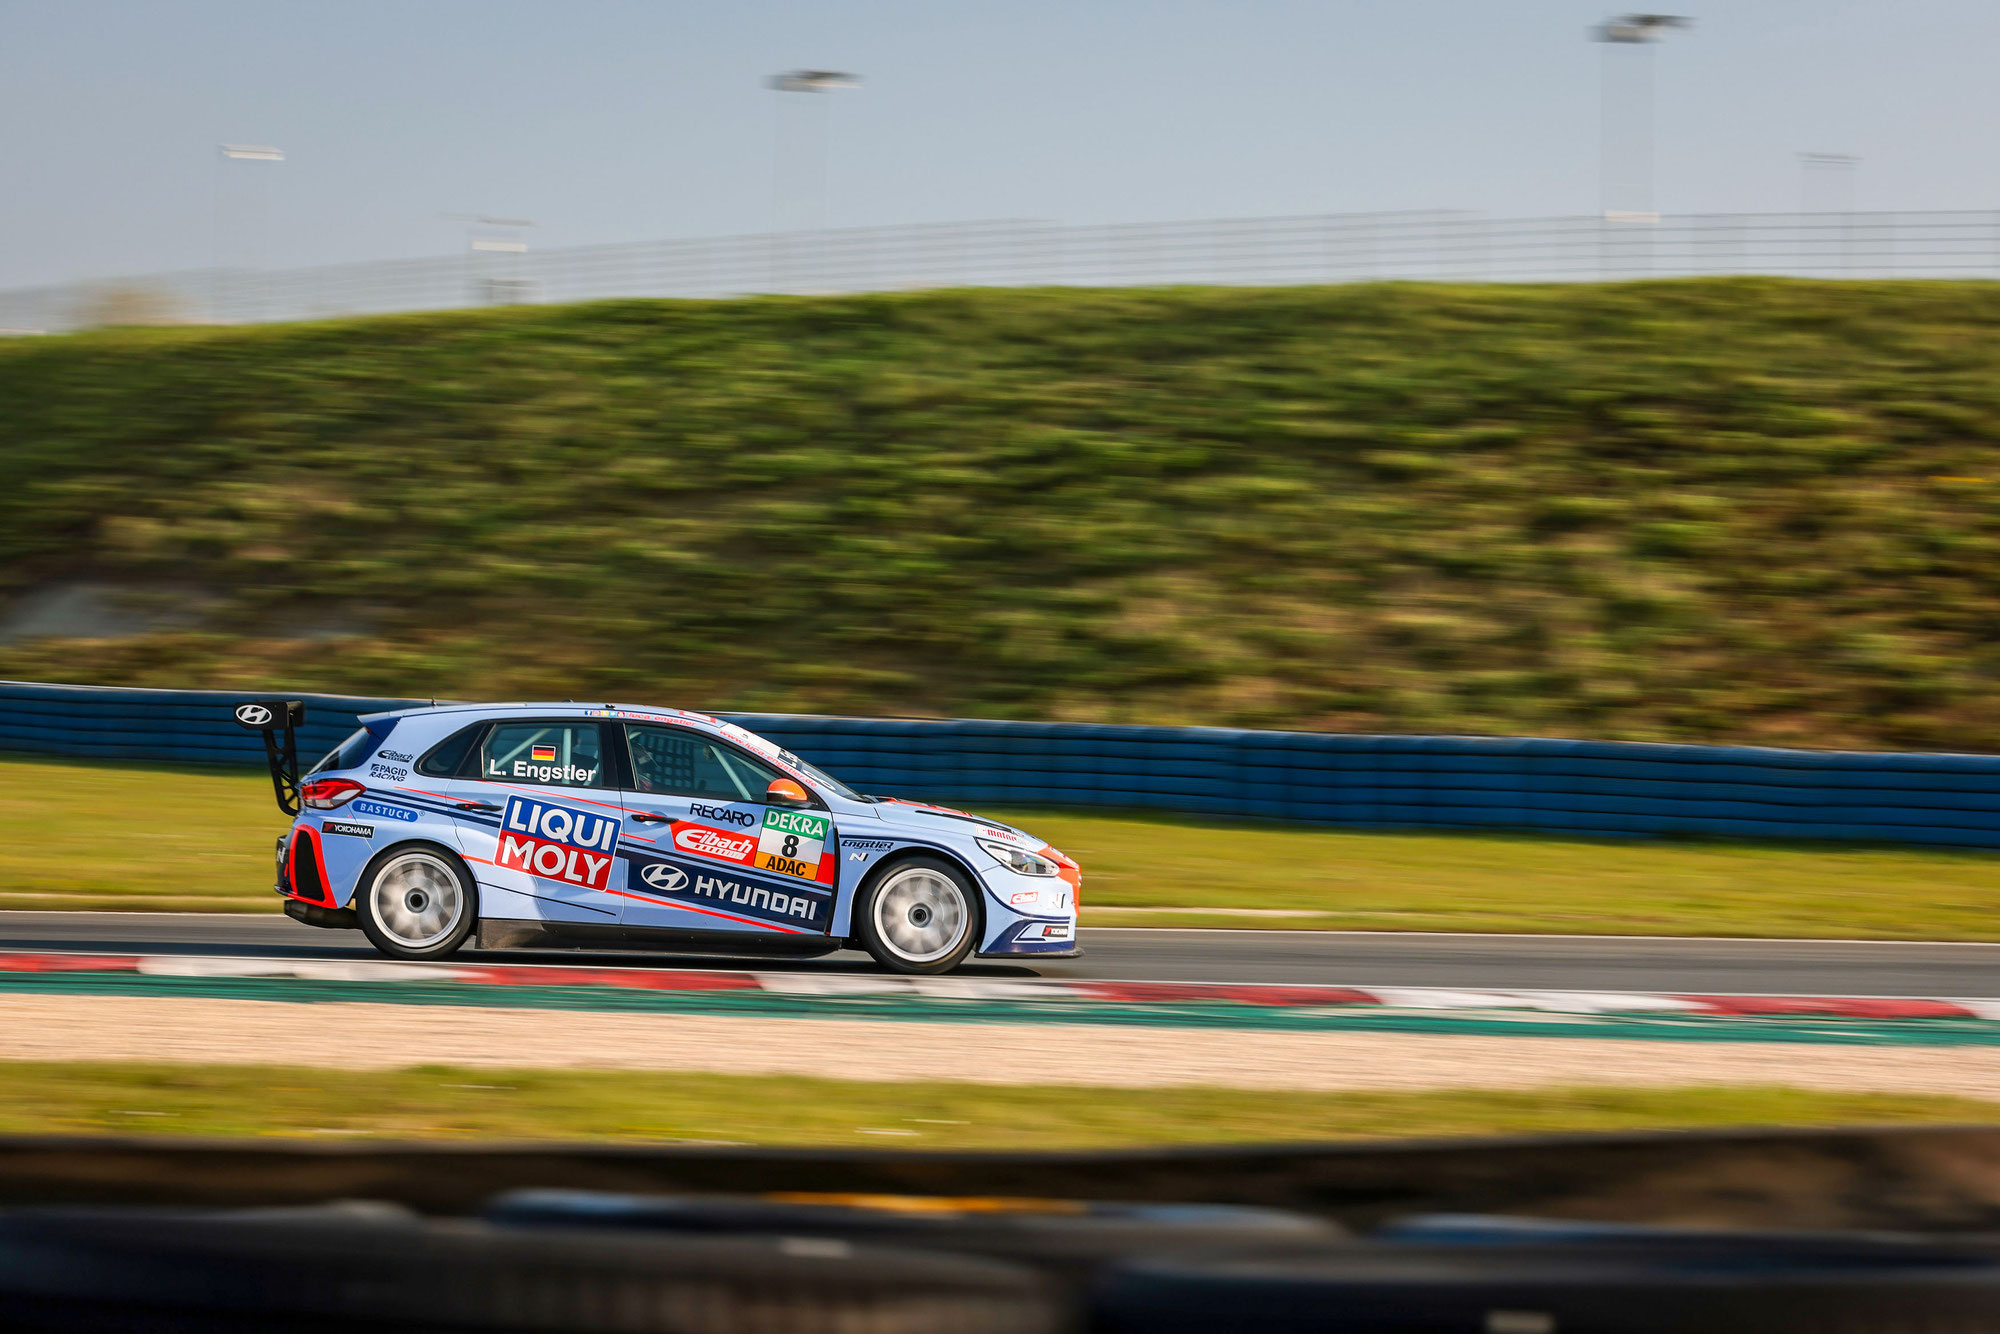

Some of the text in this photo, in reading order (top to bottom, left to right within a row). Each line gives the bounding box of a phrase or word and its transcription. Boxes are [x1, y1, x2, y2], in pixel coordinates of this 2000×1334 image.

[369, 772, 406, 783] RACING
[380, 765, 408, 777] PAGID
[490, 759, 597, 782] L. Engstler
[360, 802, 411, 821] BASTUCK
[690, 803, 755, 827] RECARO
[334, 824, 372, 836] YOKOHAMA
[508, 799, 615, 851] LIQUI
[766, 811, 824, 838] DEKRA
[675, 829, 754, 855] Eibach
[781, 835, 800, 858] 8
[841, 840, 894, 849] Engstler
[500, 834, 611, 886] MOLY
[765, 856, 807, 877] ADAC
[694, 875, 817, 921] HYUNDAI
